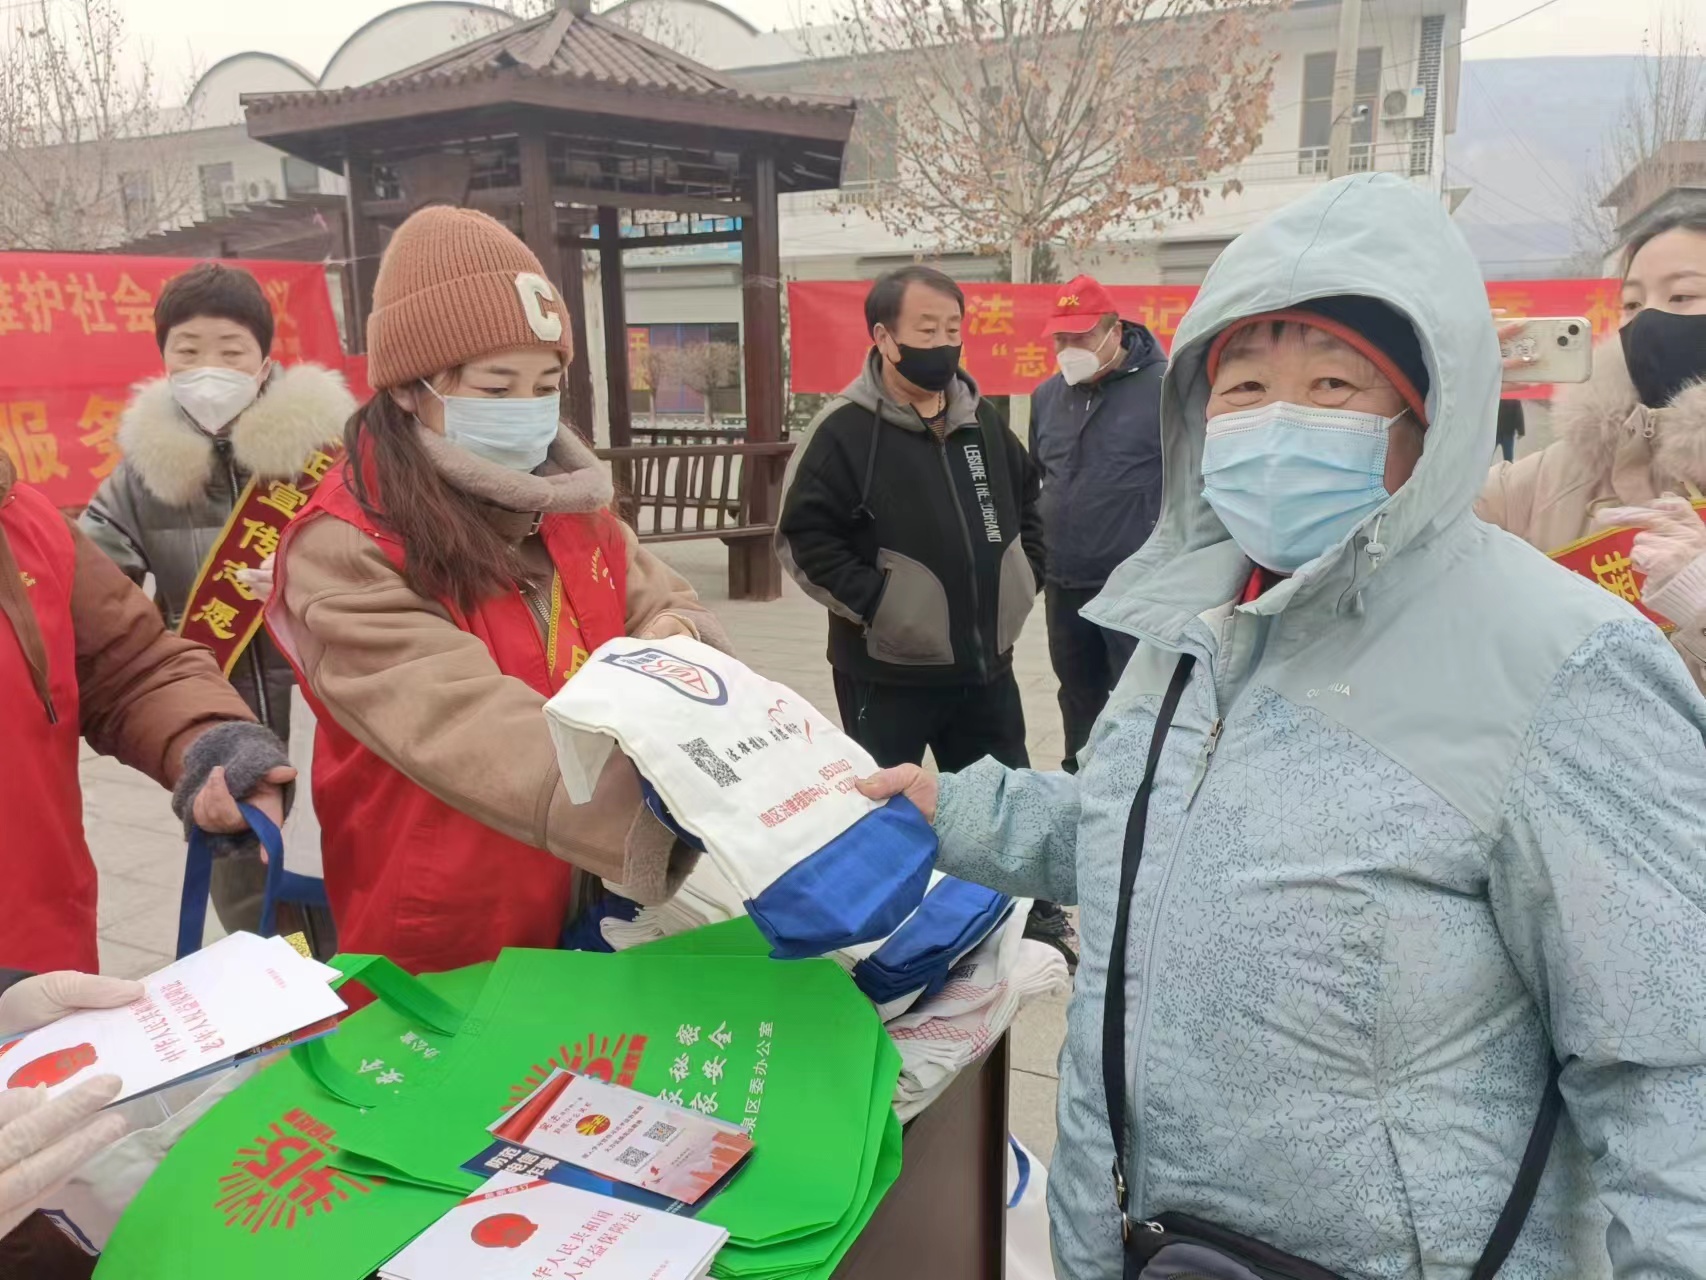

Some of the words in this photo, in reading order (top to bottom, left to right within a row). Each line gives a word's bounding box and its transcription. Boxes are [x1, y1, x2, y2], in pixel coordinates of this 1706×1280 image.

[515, 272, 563, 342] C
[740, 1021, 774, 1139] 泉区委办公室
